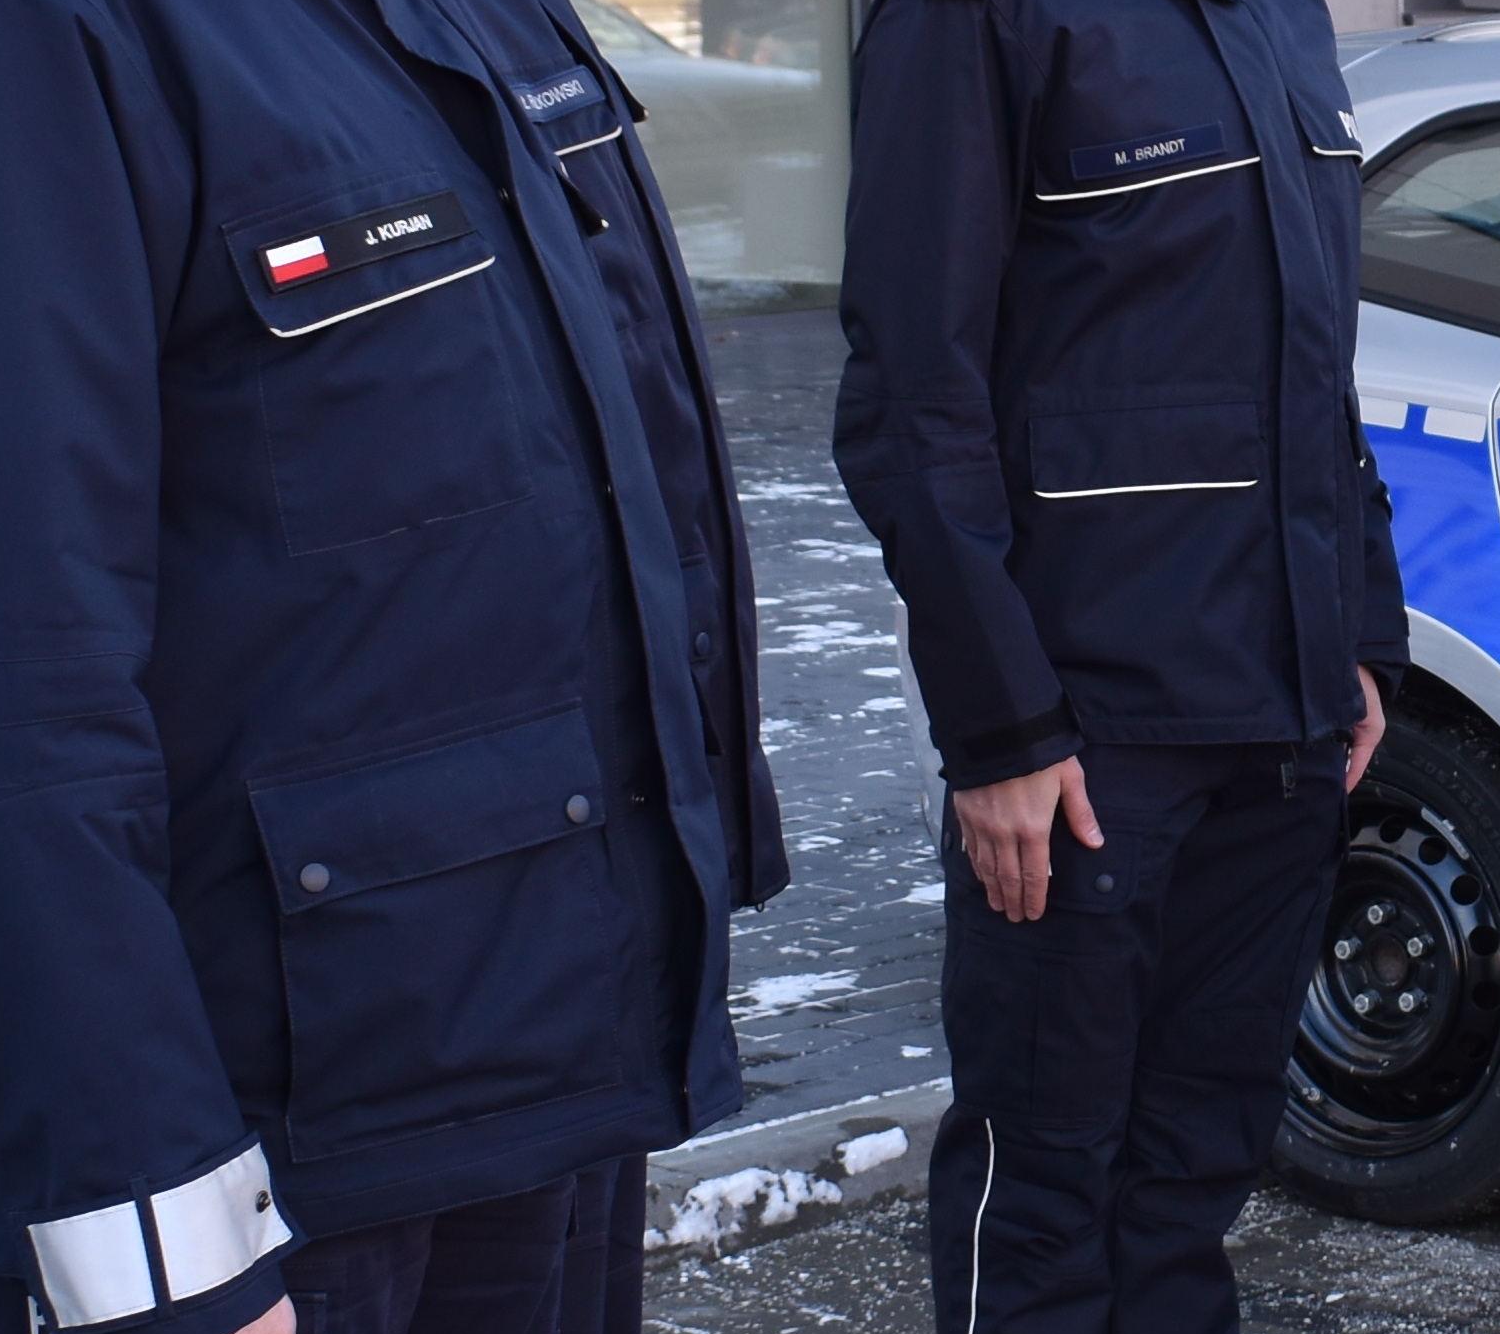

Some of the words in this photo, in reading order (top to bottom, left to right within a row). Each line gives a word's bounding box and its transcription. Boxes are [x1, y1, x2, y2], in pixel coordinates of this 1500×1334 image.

[1114, 151, 1132, 165] M.
[1135, 138, 1185, 161] BRANDT
[365, 229, 380, 245] J.
[376, 213, 433, 241] KURJAN
